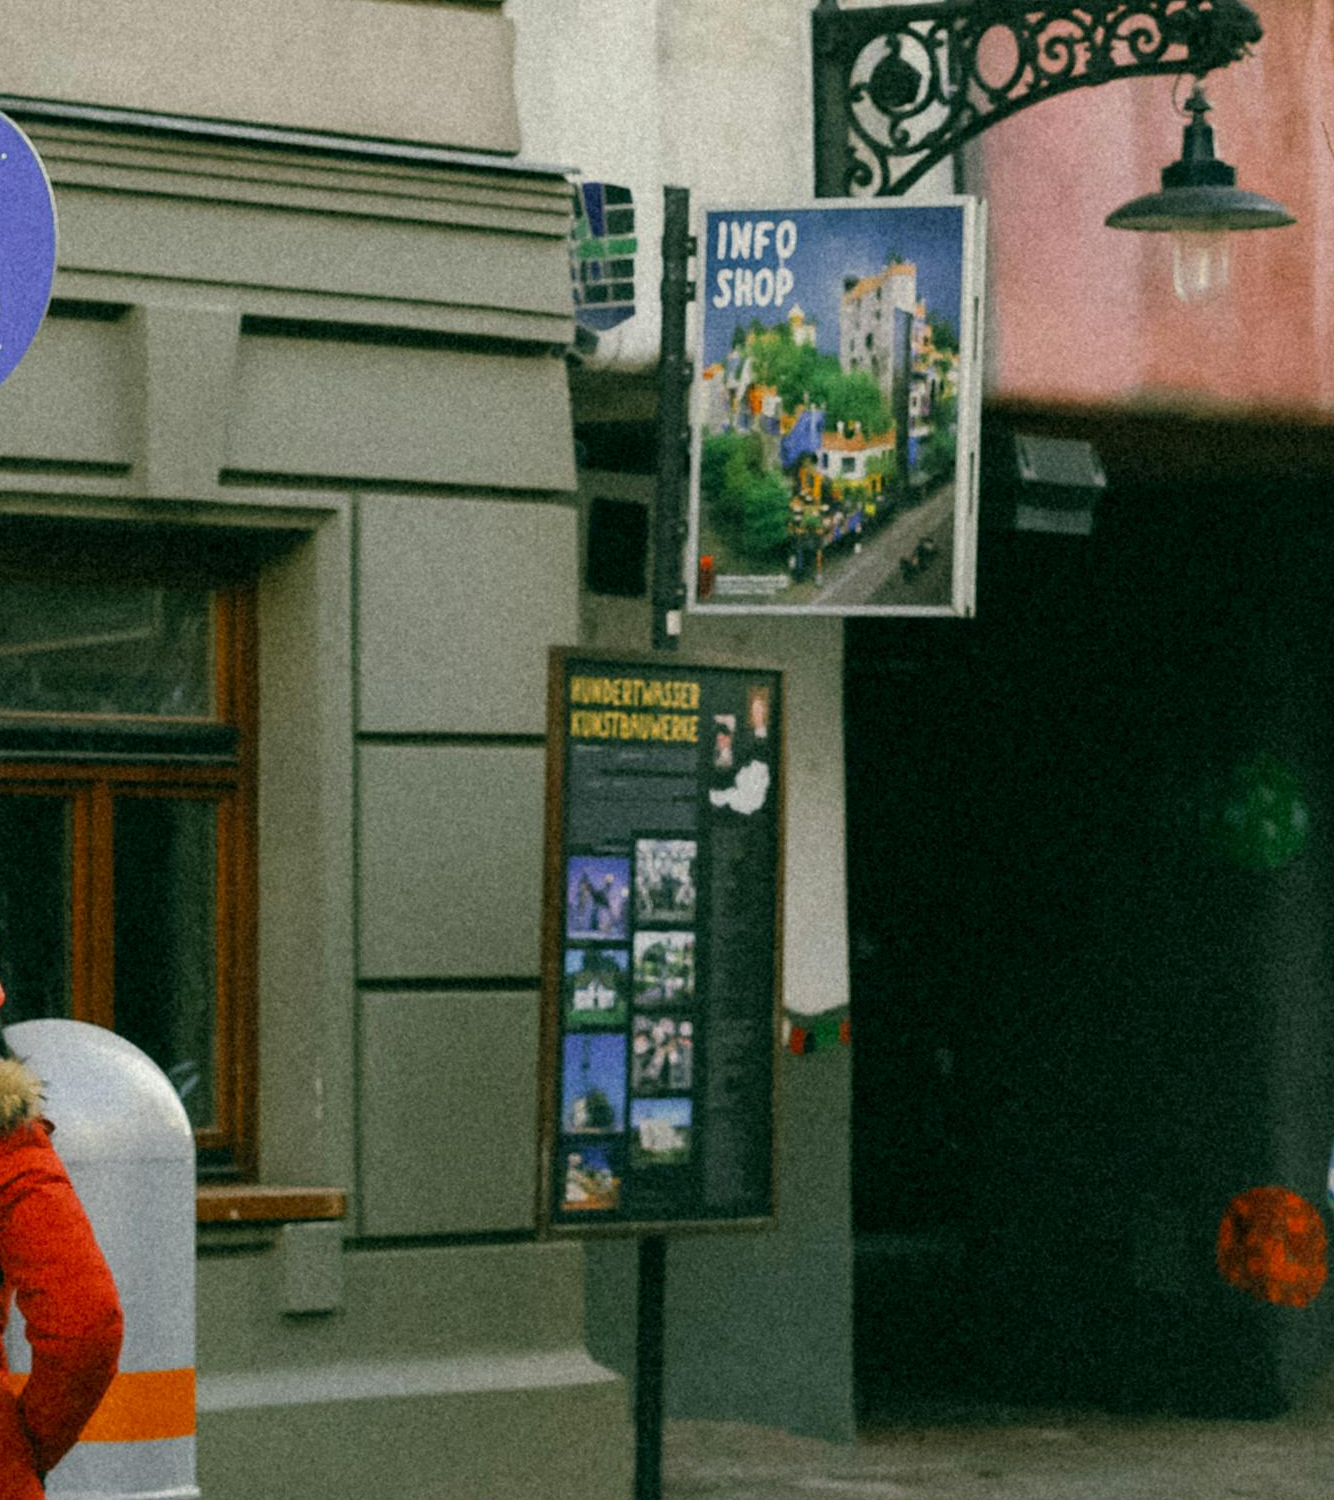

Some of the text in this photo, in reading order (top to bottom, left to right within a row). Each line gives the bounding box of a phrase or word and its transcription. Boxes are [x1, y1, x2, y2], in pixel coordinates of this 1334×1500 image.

[717, 220, 798, 260] INFO
[713, 267, 794, 308] SHOP
[570, 676, 700, 709] HUNDERTWASSER
